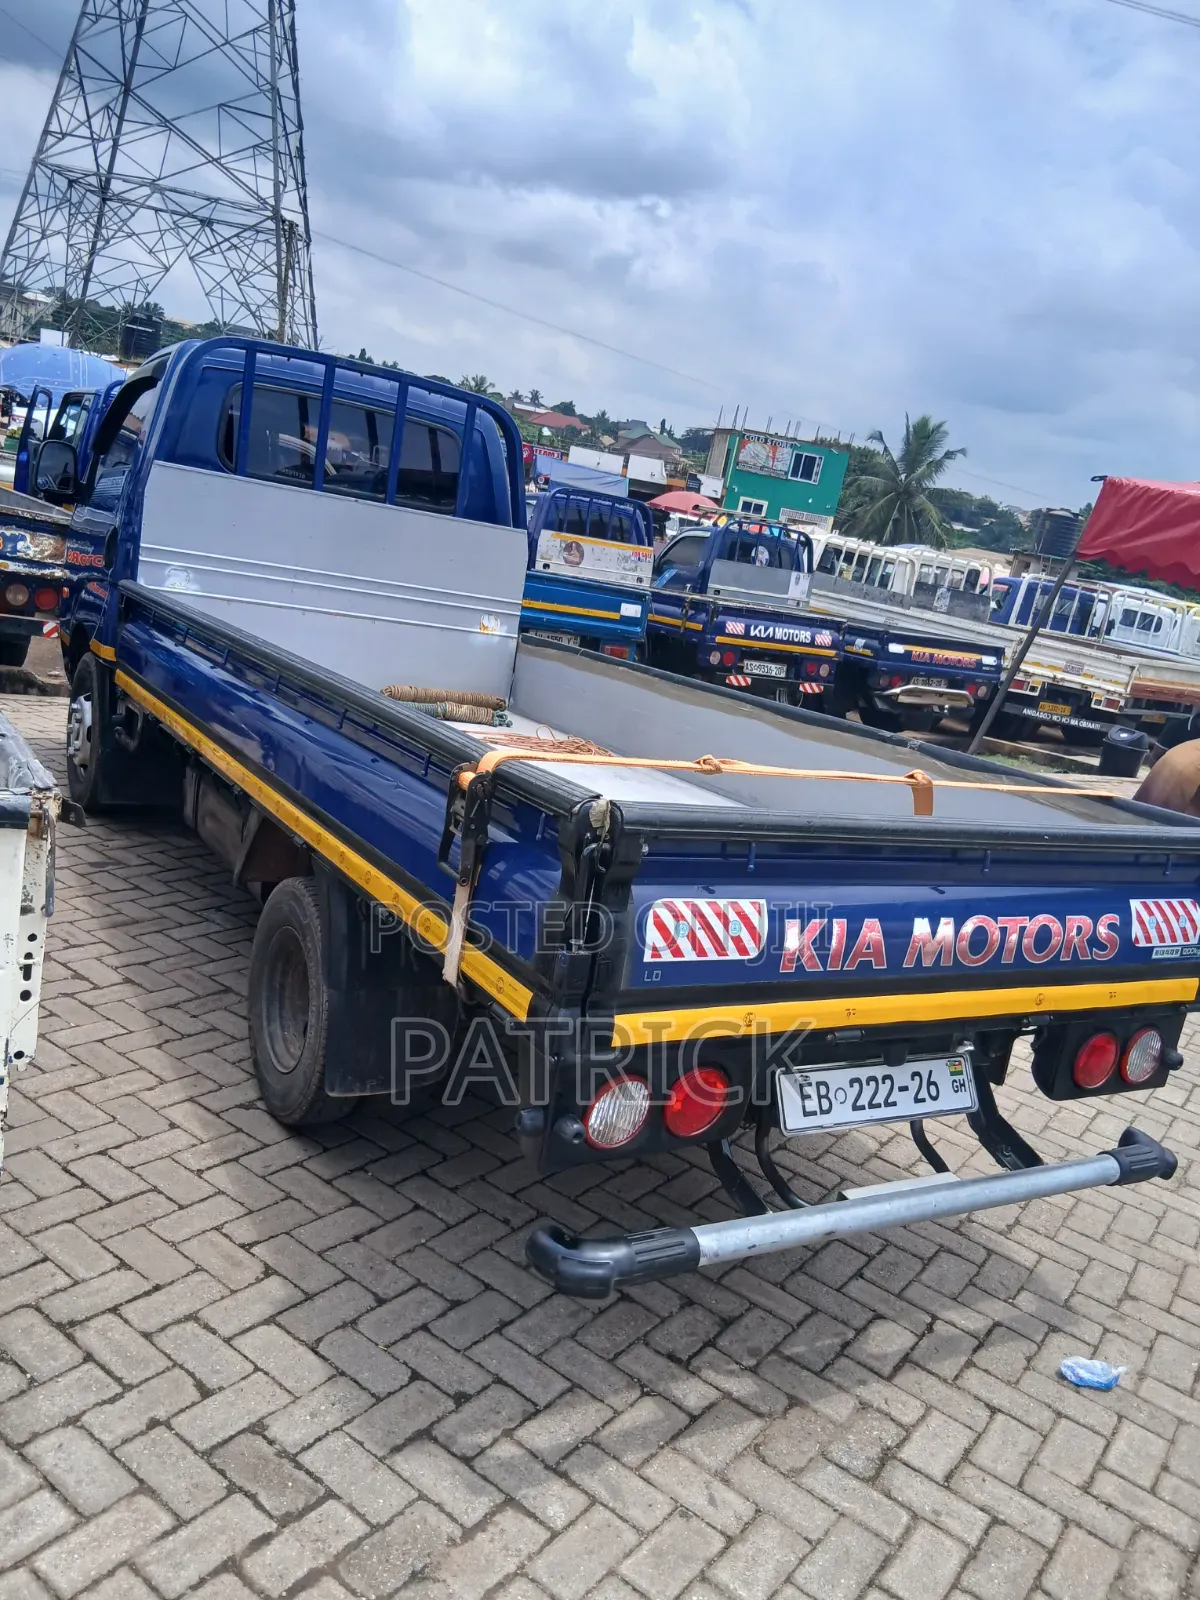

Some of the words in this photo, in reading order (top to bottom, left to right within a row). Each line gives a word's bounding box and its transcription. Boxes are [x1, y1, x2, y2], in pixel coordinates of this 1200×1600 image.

[744, 434, 765, 444] COLD
[534, 447, 554, 459] TEAM
[750, 624, 774, 639] KIA
[775, 627, 811, 644] MOTORS
[911, 651, 930, 663] KIA
[932, 654, 977, 669] MOTORS
[780, 917, 887, 973] KIA
[903, 914, 1120, 968] MOTORS
[951, 1077, 967, 1094] GH
